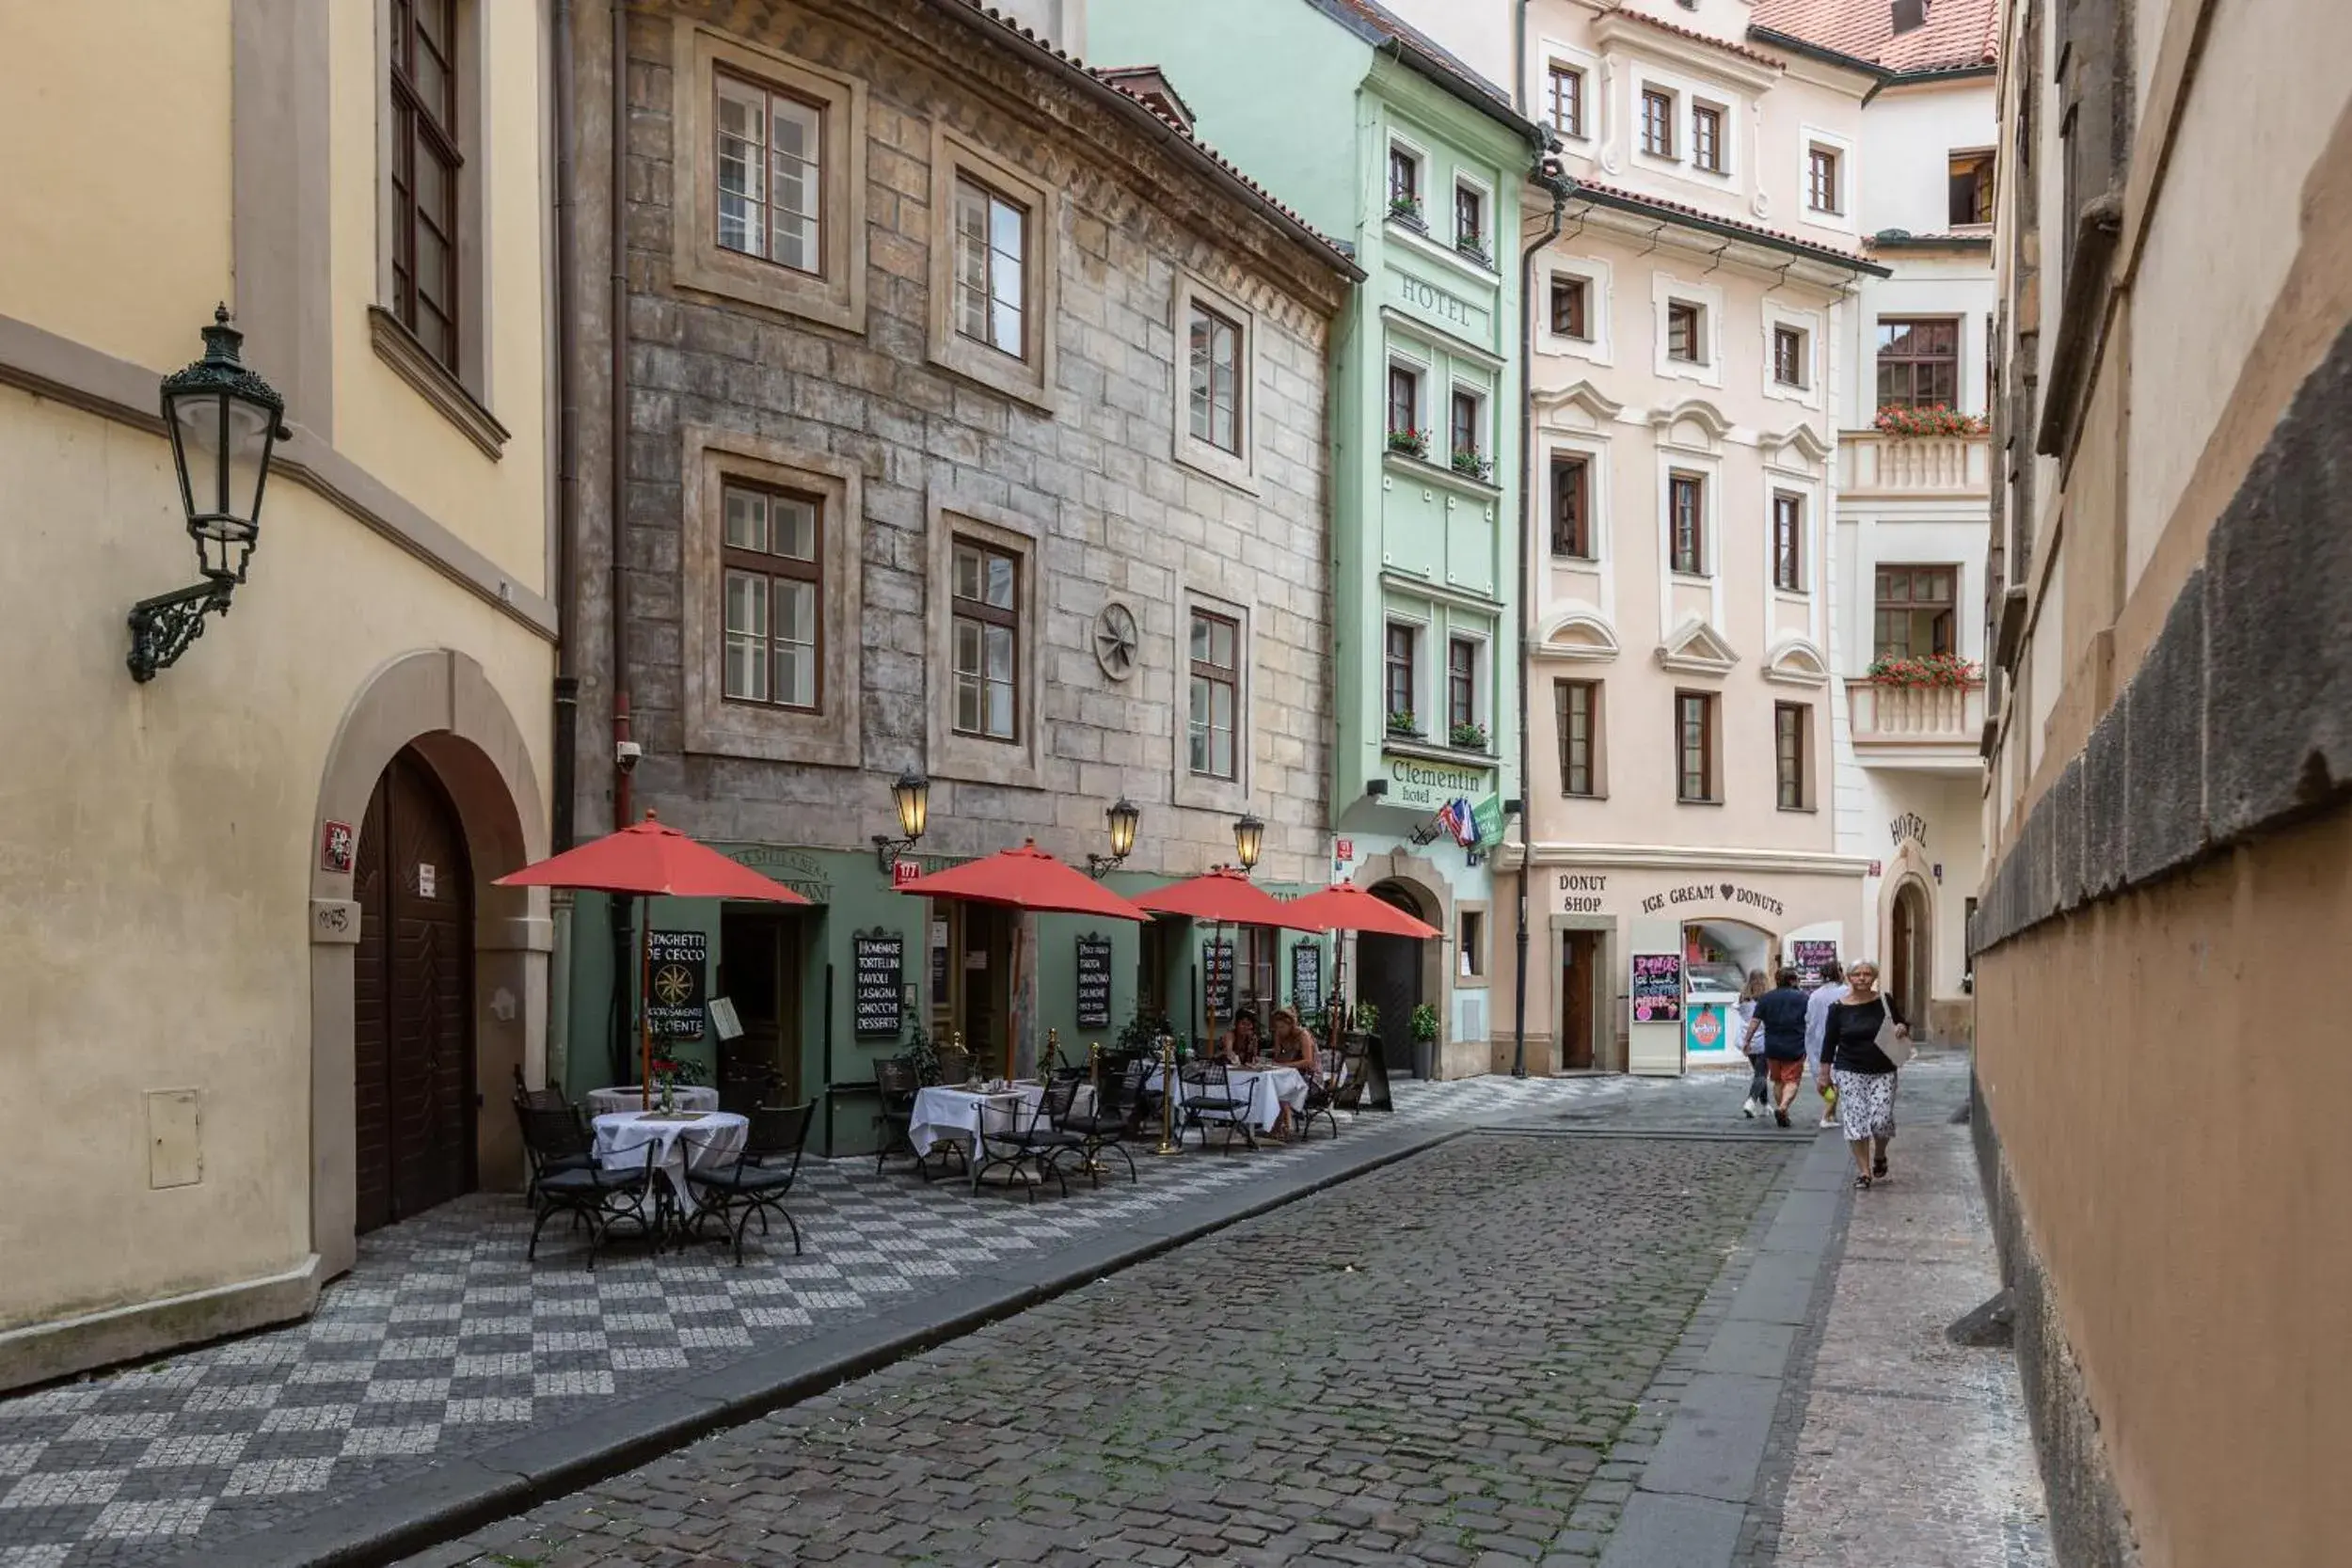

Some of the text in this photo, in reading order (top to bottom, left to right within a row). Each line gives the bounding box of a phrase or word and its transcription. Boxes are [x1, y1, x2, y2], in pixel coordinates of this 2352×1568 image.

[1403, 274, 1470, 327] HOTEL
[1391, 759, 1480, 792] Clementin
[1402, 785, 1430, 804] hotel
[1890, 813, 1927, 847] HOTEL
[899, 863, 917, 877] 177
[1559, 875, 1607, 891] DONUT
[1564, 896, 1603, 912] SHOP
[1642, 884, 1785, 916] ICE CREAM DONUTS
[665, 948, 706, 960] CECCO
[858, 973, 889, 984] RAVIOLI
[858, 987, 898, 999] LASAGNA
[858, 1002, 898, 1014] GNOCCHI
[858, 1017, 899, 1029] DESSERTS
